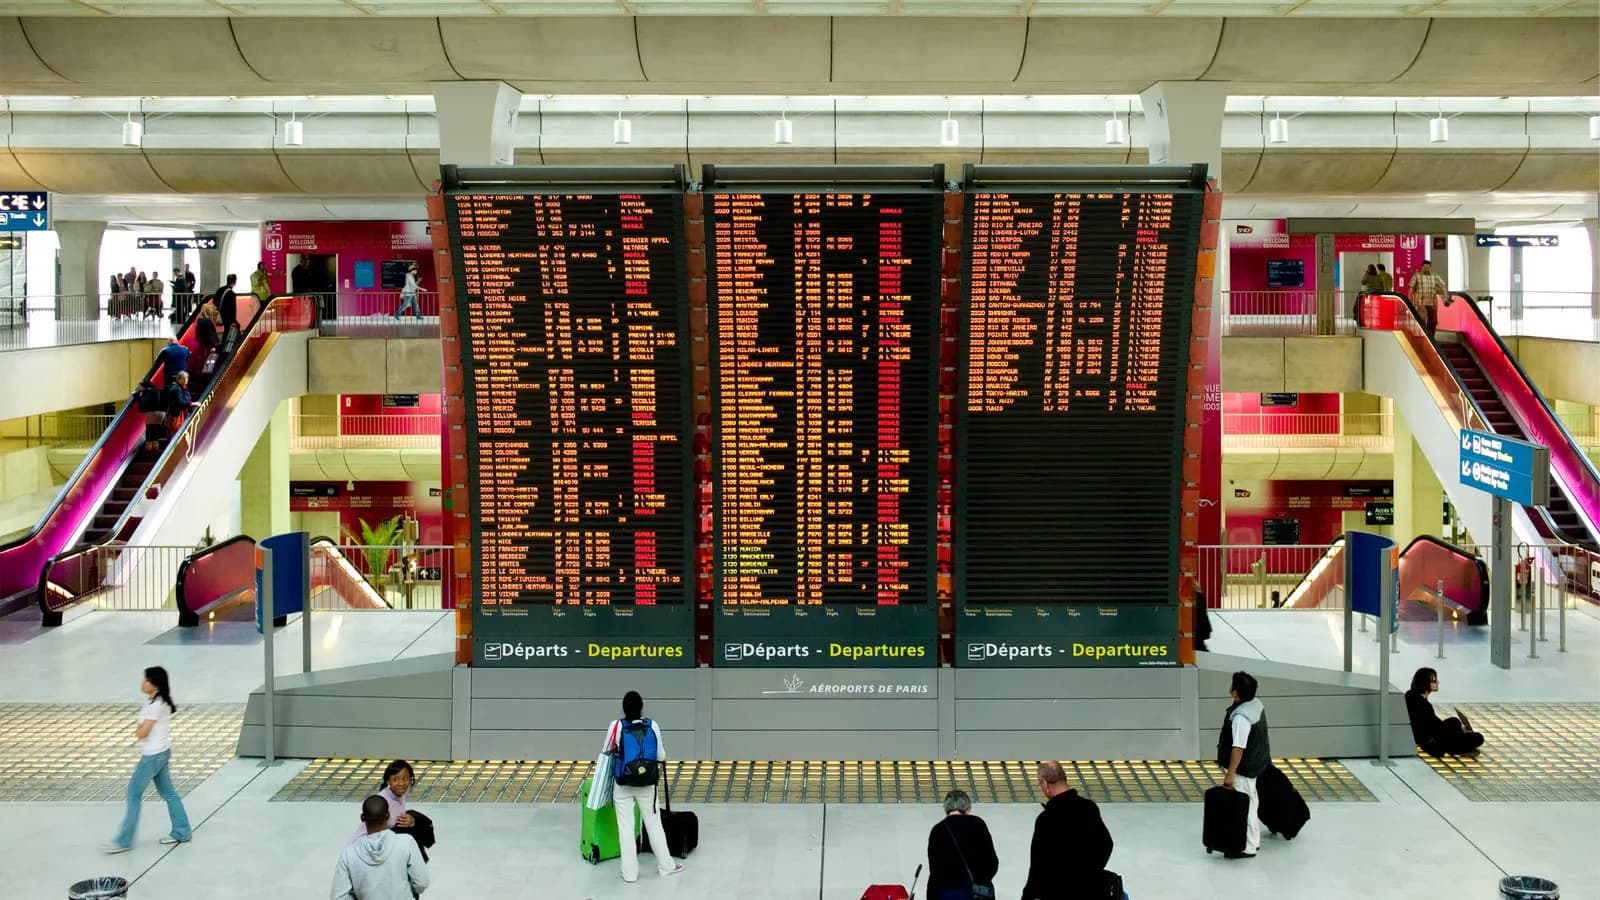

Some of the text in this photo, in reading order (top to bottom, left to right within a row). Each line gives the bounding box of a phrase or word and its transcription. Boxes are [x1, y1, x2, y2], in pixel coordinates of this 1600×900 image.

[503, 643, 682, 660] Départs Departures
[743, 643, 924, 660] Départs Departures
[986, 643, 1167, 660] Départs Departures
[809, 682, 928, 693] AÉROPORTS DE PARIS
